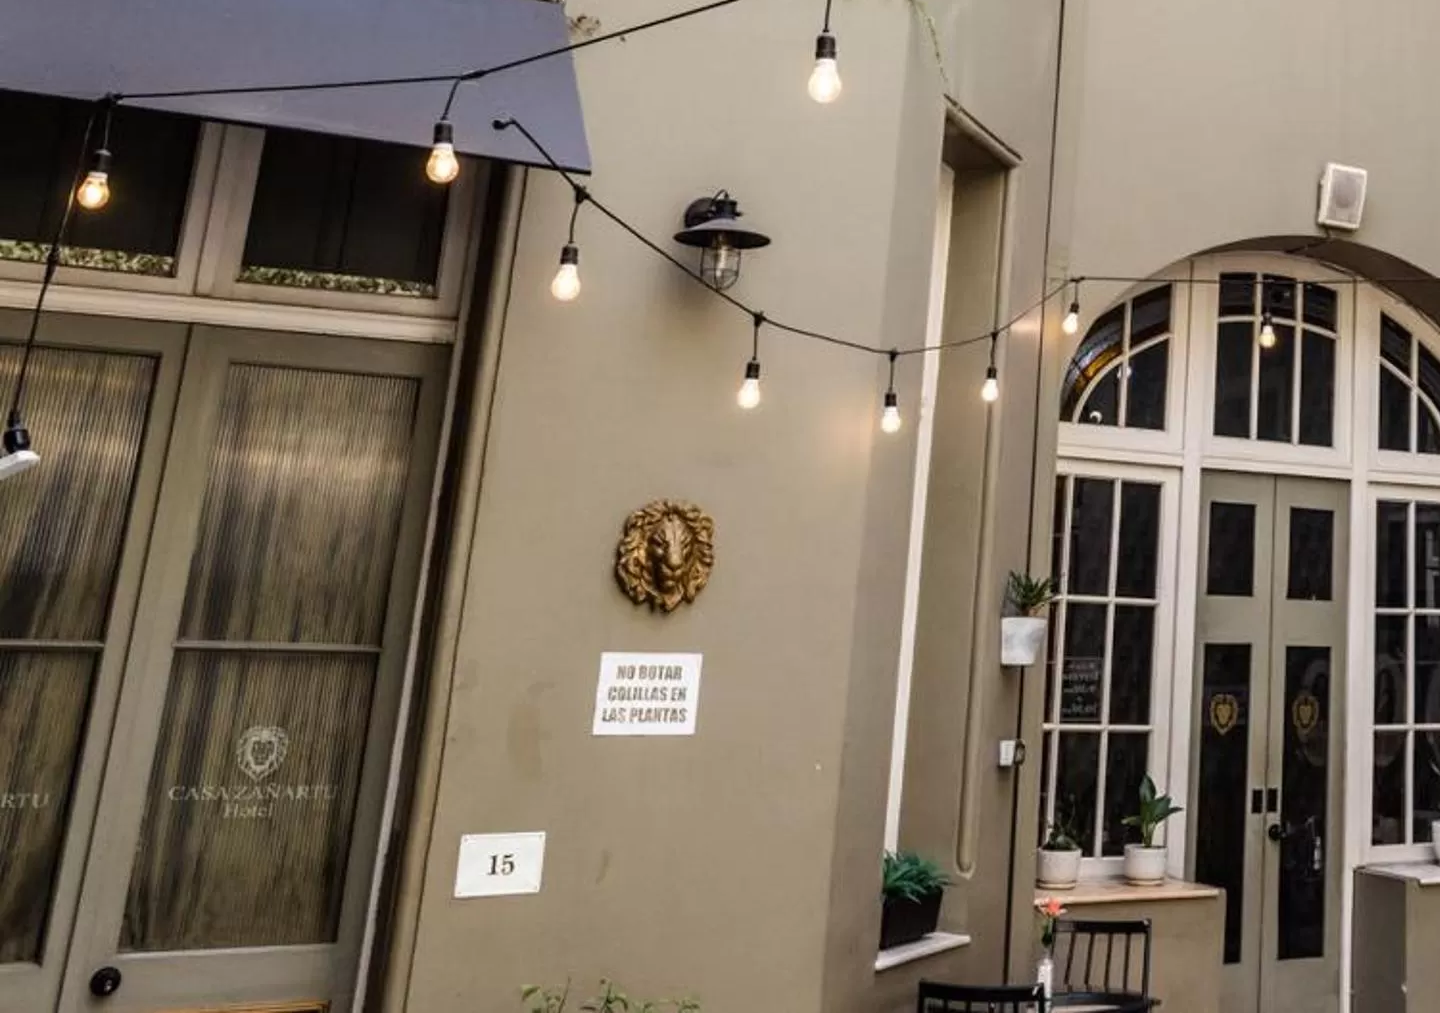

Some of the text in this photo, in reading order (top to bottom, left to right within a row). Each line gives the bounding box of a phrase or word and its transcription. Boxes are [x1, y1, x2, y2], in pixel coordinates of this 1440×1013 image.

[616, 665, 683, 680] NO BOTAR
[607, 686, 687, 701] COLILLAS EN
[602, 707, 688, 723] LAS PLANTAS
[223, 802, 274, 819] Hotel
[487, 854, 515, 876] 15
